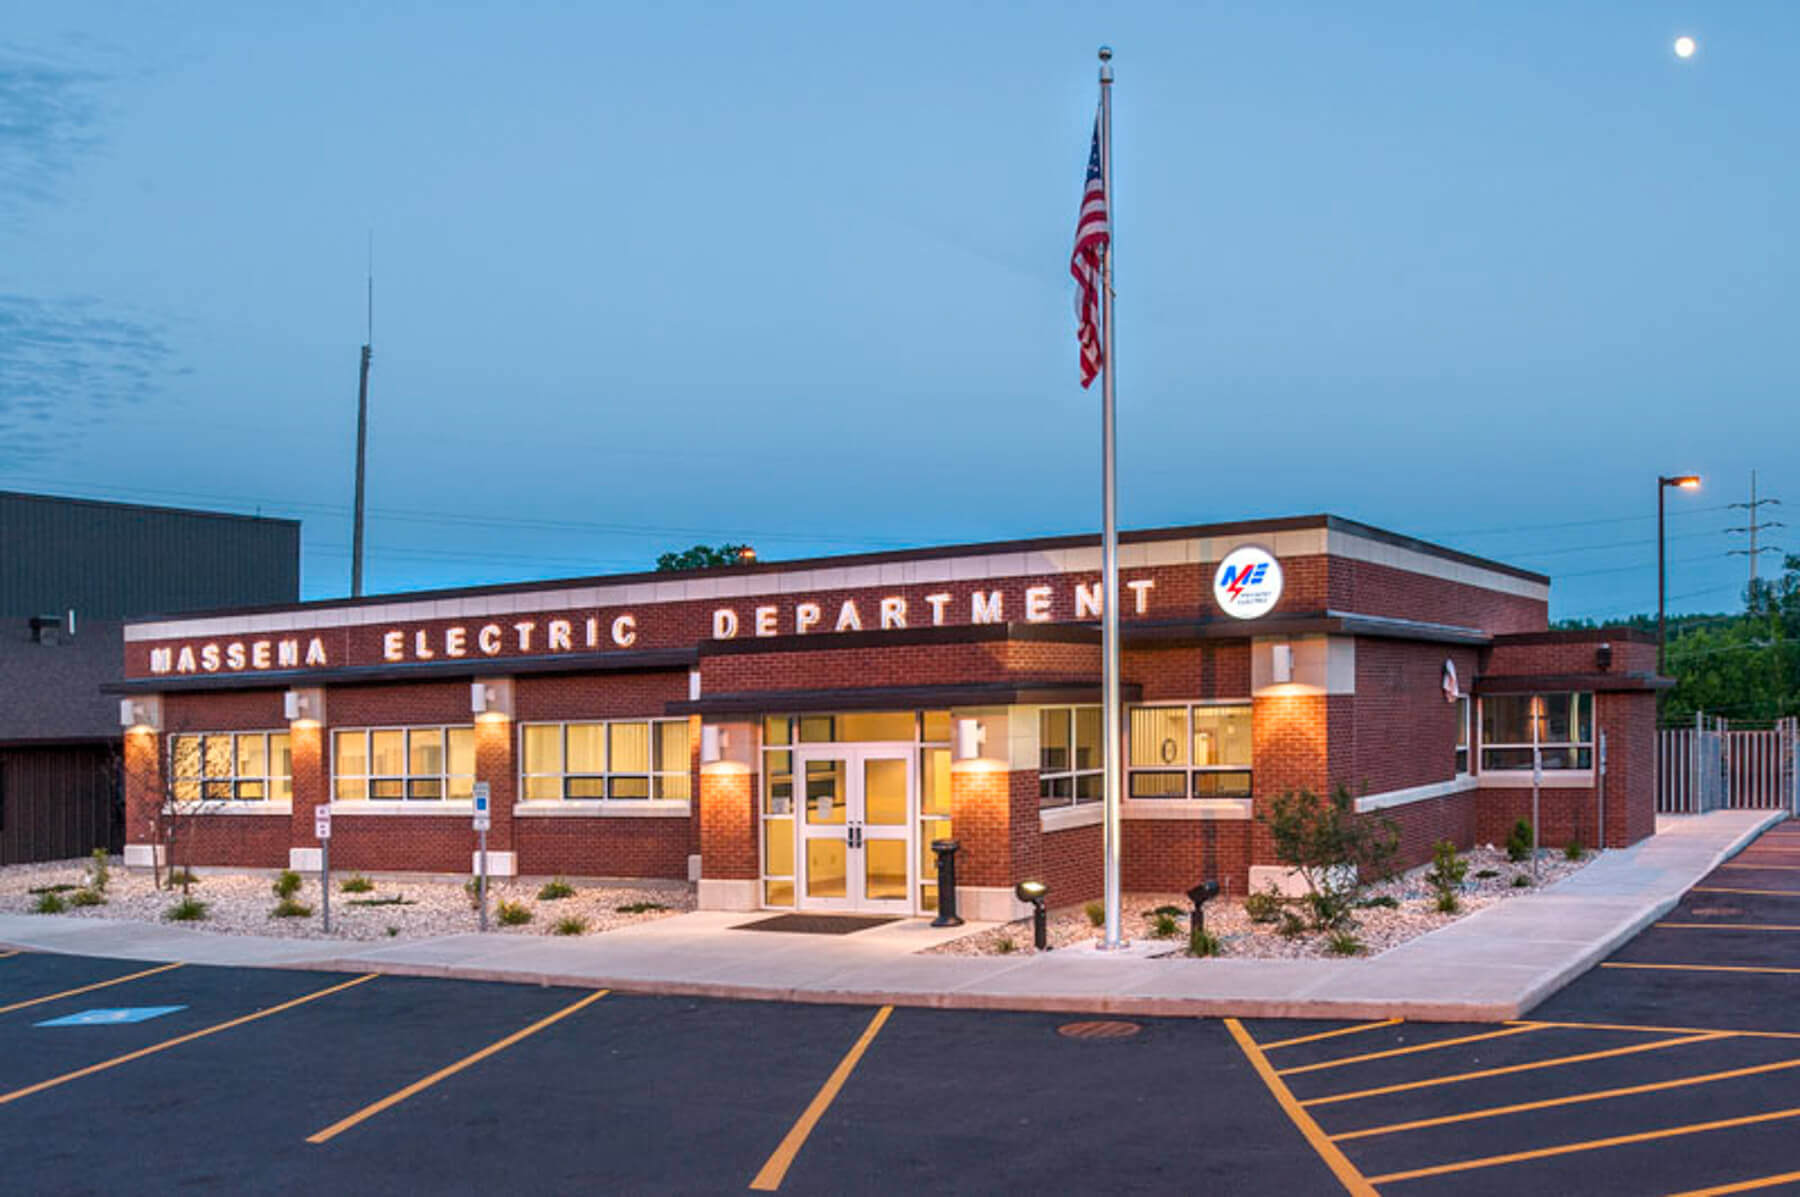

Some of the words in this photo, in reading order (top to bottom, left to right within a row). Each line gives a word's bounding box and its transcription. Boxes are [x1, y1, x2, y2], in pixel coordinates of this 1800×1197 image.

[150, 637, 327, 673] MASSENA
[383, 614, 637, 661] ELECTRIC
[712, 579, 1155, 640] DEPARTMENT
